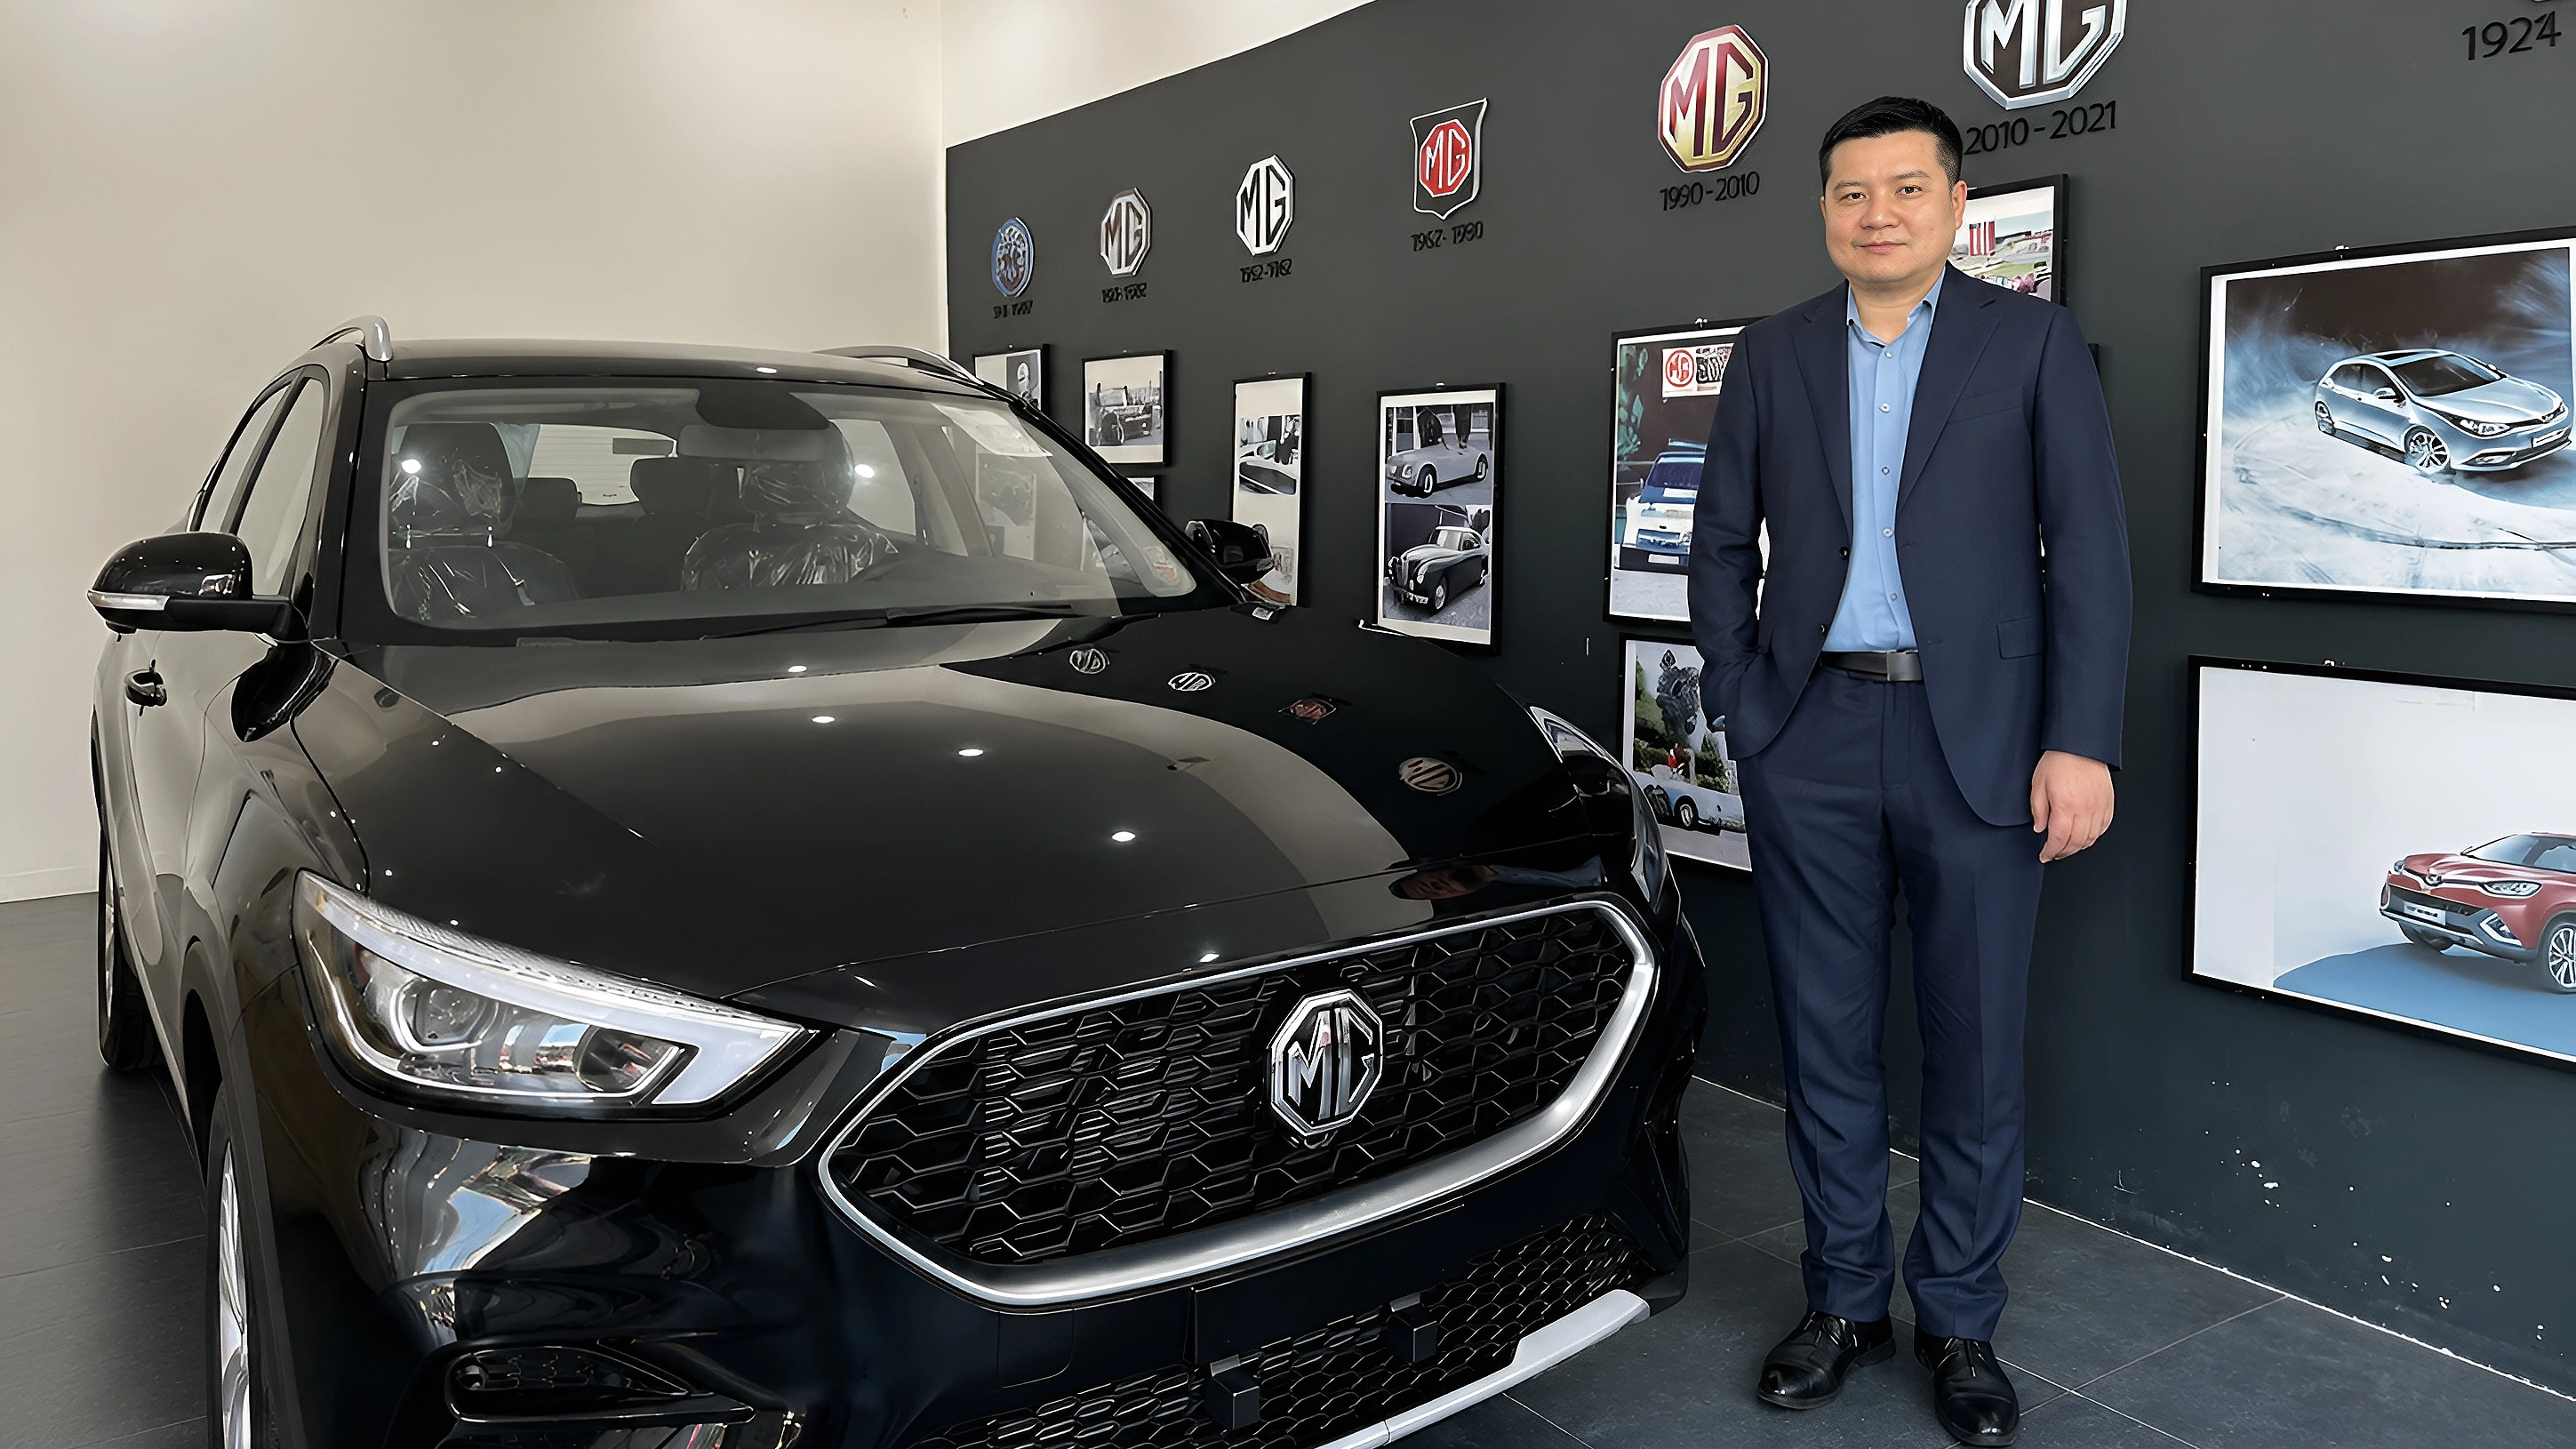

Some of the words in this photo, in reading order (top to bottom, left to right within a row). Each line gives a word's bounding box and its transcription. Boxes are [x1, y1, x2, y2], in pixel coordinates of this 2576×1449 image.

[1980, 0, 2107, 89] MG
[2461, 11, 2562, 60] 1924
[1669, 42, 1754, 156] MG
[1425, 129, 1466, 188] MG
[1660, 172, 1760, 211] 1990-2010
[1241, 164, 1286, 247] MG
[1288, 1006, 1374, 1120] MG
